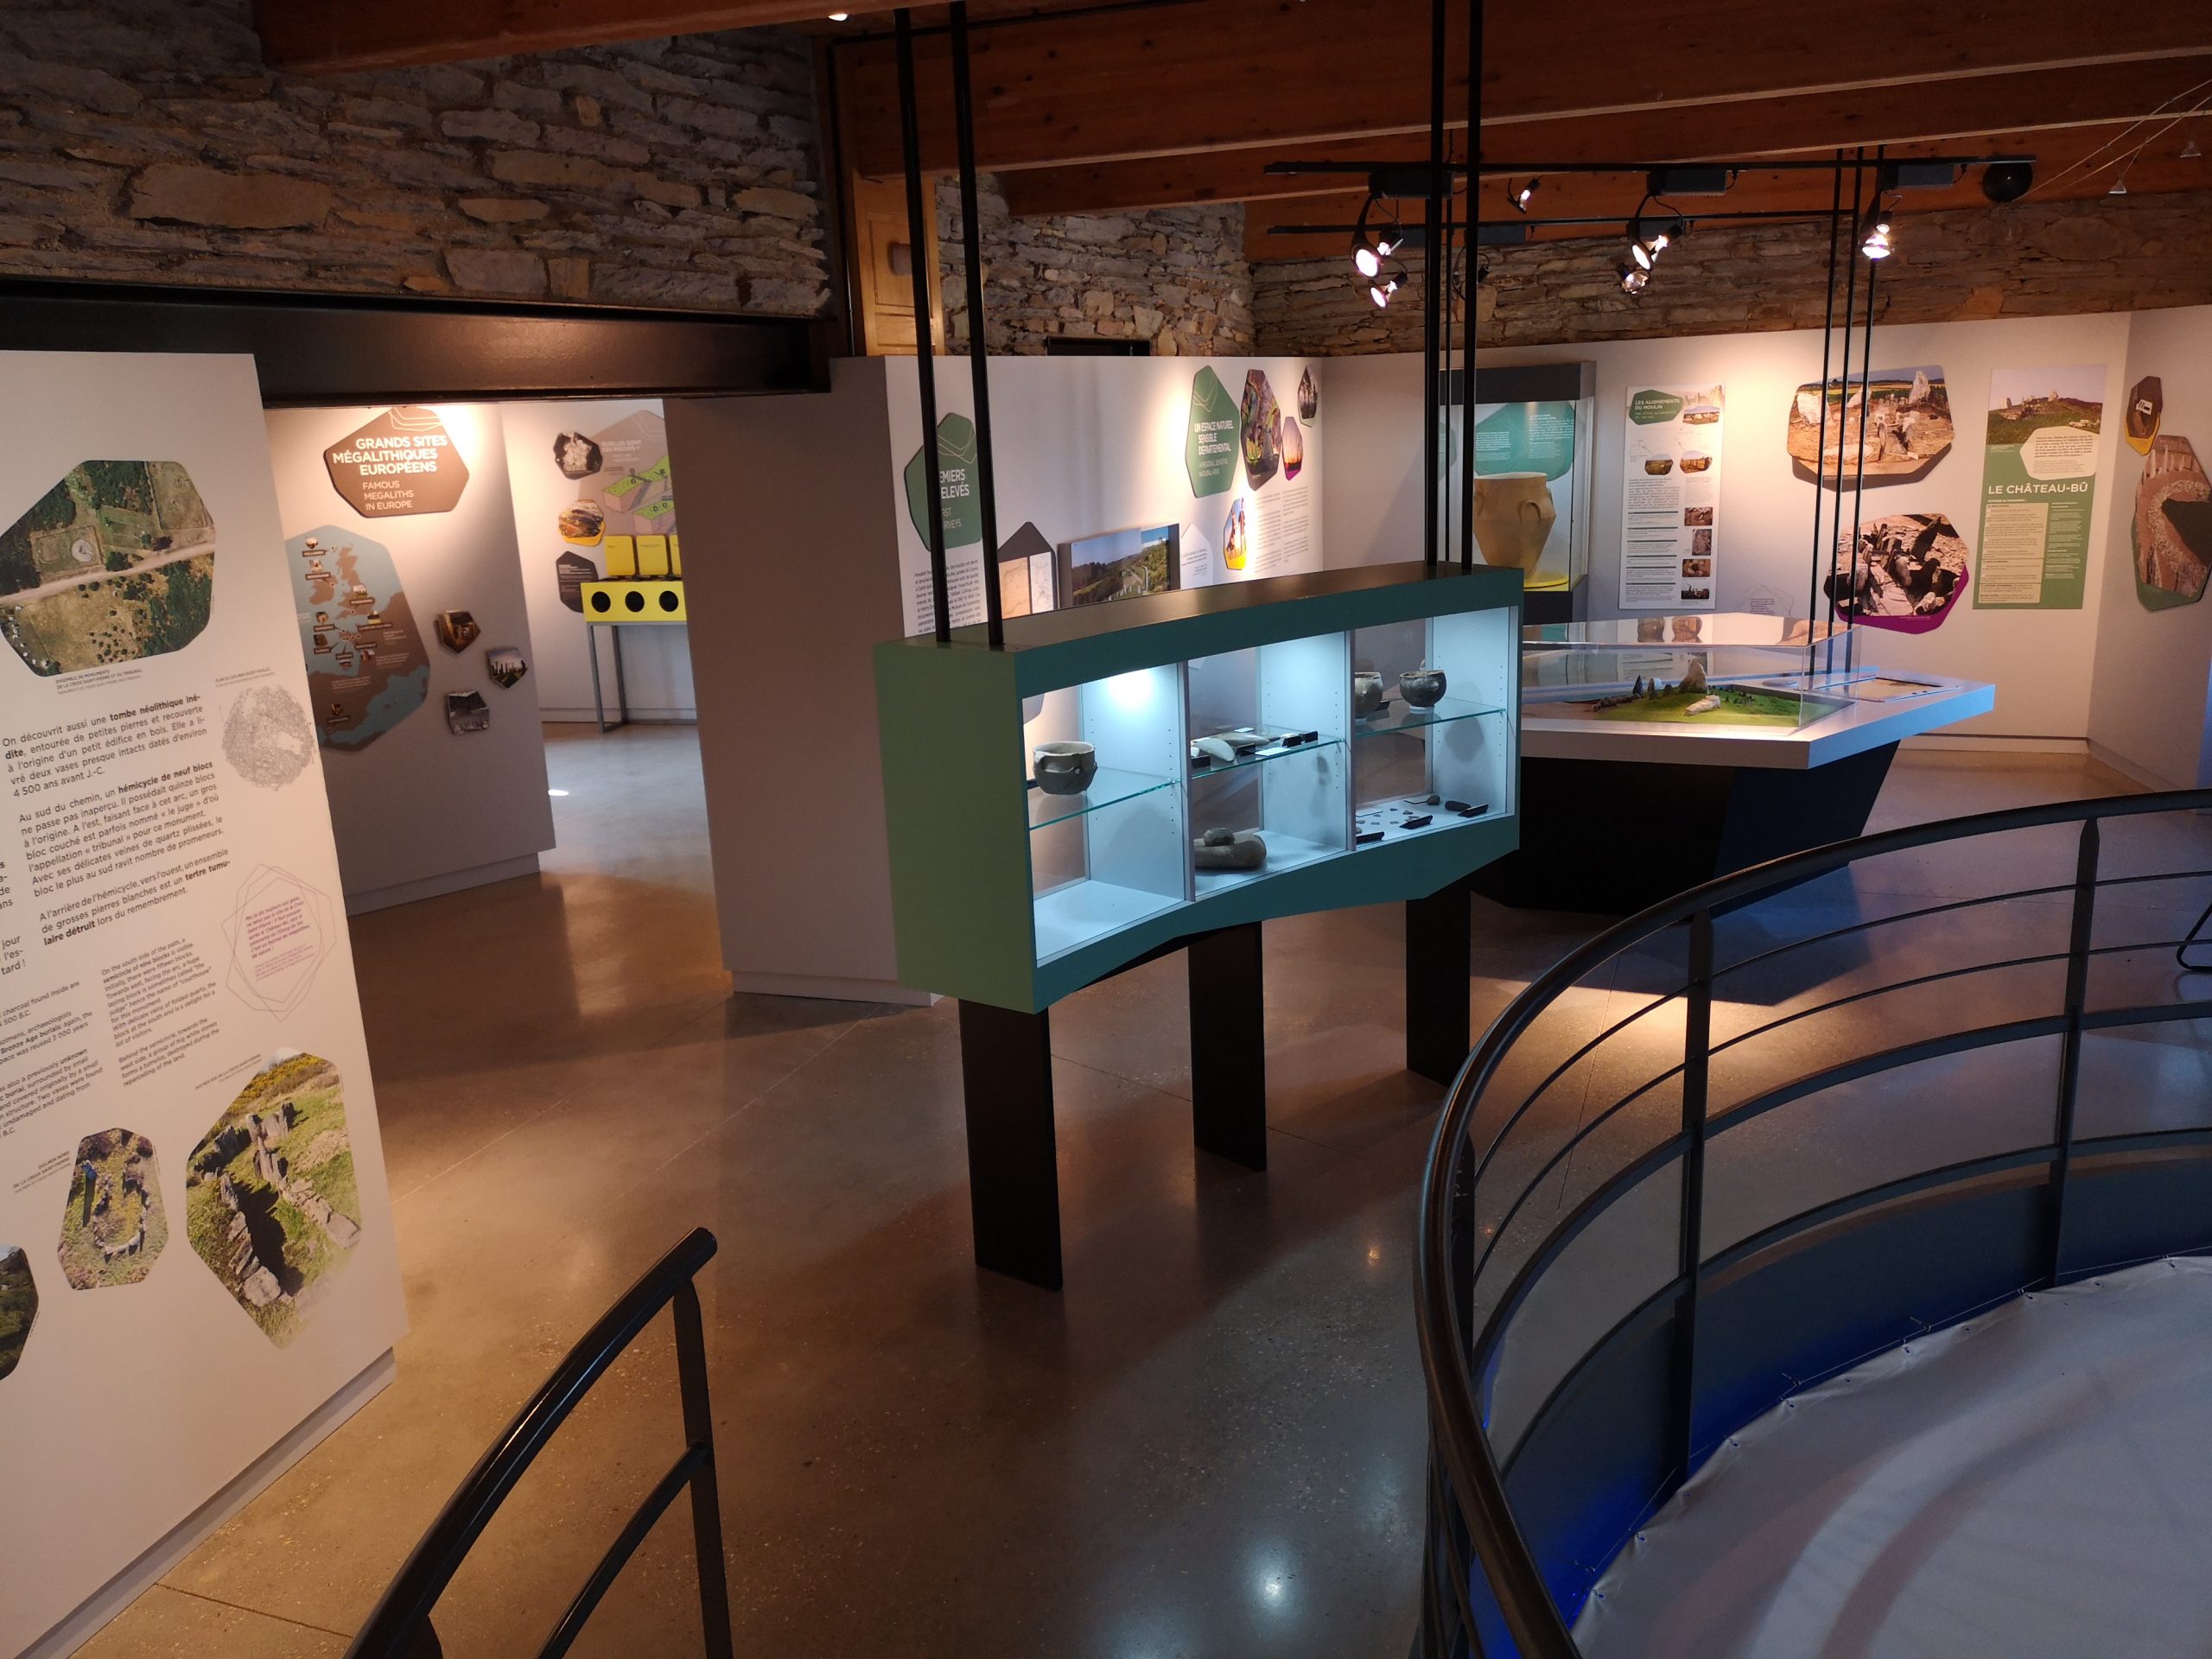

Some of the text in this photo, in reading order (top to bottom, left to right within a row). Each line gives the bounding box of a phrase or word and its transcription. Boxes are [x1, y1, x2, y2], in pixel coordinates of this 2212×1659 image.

[355, 435, 448, 449] GRANDS SITES
[1194, 420, 1234, 432] UN ESPACE NATUREL
[1198, 433, 1217, 443] SENSIBLE
[332, 448, 438, 464] MÉGALITHIQUES
[359, 459, 437, 475] EUROPÉENS
[939, 468, 966, 483] EMIERS
[363, 480, 400, 490] FAMOUS
[364, 490, 414, 500] MEGALITHS
[365, 500, 413, 511] IN EUROPE
[940, 481, 969, 499] ELEVÉS
[1988, 481, 2088, 494] LE CHÂTEAU-BÛ
[2, 738, 16, 747] On
[20, 726, 63, 742] découvrit
[66, 719, 87, 732] aussi
[91, 716, 106, 726] une
[109, 709, 137, 721] tombe
[139, 698, 183, 715] néolithique
[8, 764, 14, 772] à
[17, 755, 54, 770] l'origine
[58, 749, 78, 759] d'un
[81, 742, 101, 755] petit
[105, 735, 132, 747] édifice
[171, 721, 186, 730] Elle
[30, 738, 69, 753] entourée
[73, 734, 85, 742] de
[88, 727, 117, 741] petites
[120, 719, 148, 733] pierres
[162, 706, 202, 721] recouverte
[10, 728, 207, 785] vré deux vases presque intacts datés d'environ
[43, 779, 59, 789] ans
[60, 772, 85, 785] avant
[19, 814, 32, 823] Au
[35, 806, 51, 818] sud
[54, 804, 66, 812] du
[118, 777, 158, 794] hémicycle
[173, 766, 190, 778] neuf
[192, 761, 213, 772] blocs
[21, 827, 33, 836] ne
[35, 818, 60, 833] passe
[63, 813, 79, 824] pas
[120, 797, 126, 805] Il
[128, 786, 166, 804] possédait
[168, 779, 193, 791] quinze
[194, 772, 214, 784] blocs
[23, 839, 30, 848] à
[31, 829, 70, 845] l'origine.
[103, 809, 130, 823] faisant
[132, 804, 149, 814] face
[159, 797, 171, 806] cet
[200, 784, 217, 795] gros
[26, 849, 46, 860] bloc
[49, 836, 80, 853] couché
[83, 832, 96, 842] est
[98, 823, 126, 839] parfois
[129, 811, 158, 828] nommé
[177, 803, 194, 814] juge
[29, 850, 83, 873] l'appellation
[92, 835, 124, 852] tribunal
[132, 828, 151, 840] pour
[164, 810, 206, 828] monument.
[32, 872, 54, 885] Avec
[56, 866, 71, 876] ses
[74, 853, 111, 870] délicates
[114, 843, 139, 856] veines
[143, 839, 152, 848] de
[156, 830, 180, 843] quartz
[34, 885, 54, 897] bloc
[66, 874, 84, 887] plus
[86, 871, 96, 880] au
[98, 863, 113, 874] sud
[115, 857, 133, 869] ravit
[134, 848, 164, 862] nombre
[178, 828, 223, 849] promeneurs.
[41, 924, 53, 933] de
[56, 911, 89, 930] grosses
[91, 899, 119, 917] pierres
[122, 887, 157, 904] blanches
[159, 880, 171, 890] est
[174, 877, 184, 888] un
[185, 868, 207, 880] tertre
[47, 901, 80, 918] l'arrière
[81, 897, 92, 906] de
[139, 874, 156, 885] vers
[194, 849, 228, 866] ensemble
[43, 887, 188, 945] laire détruit lors du remembrement.
